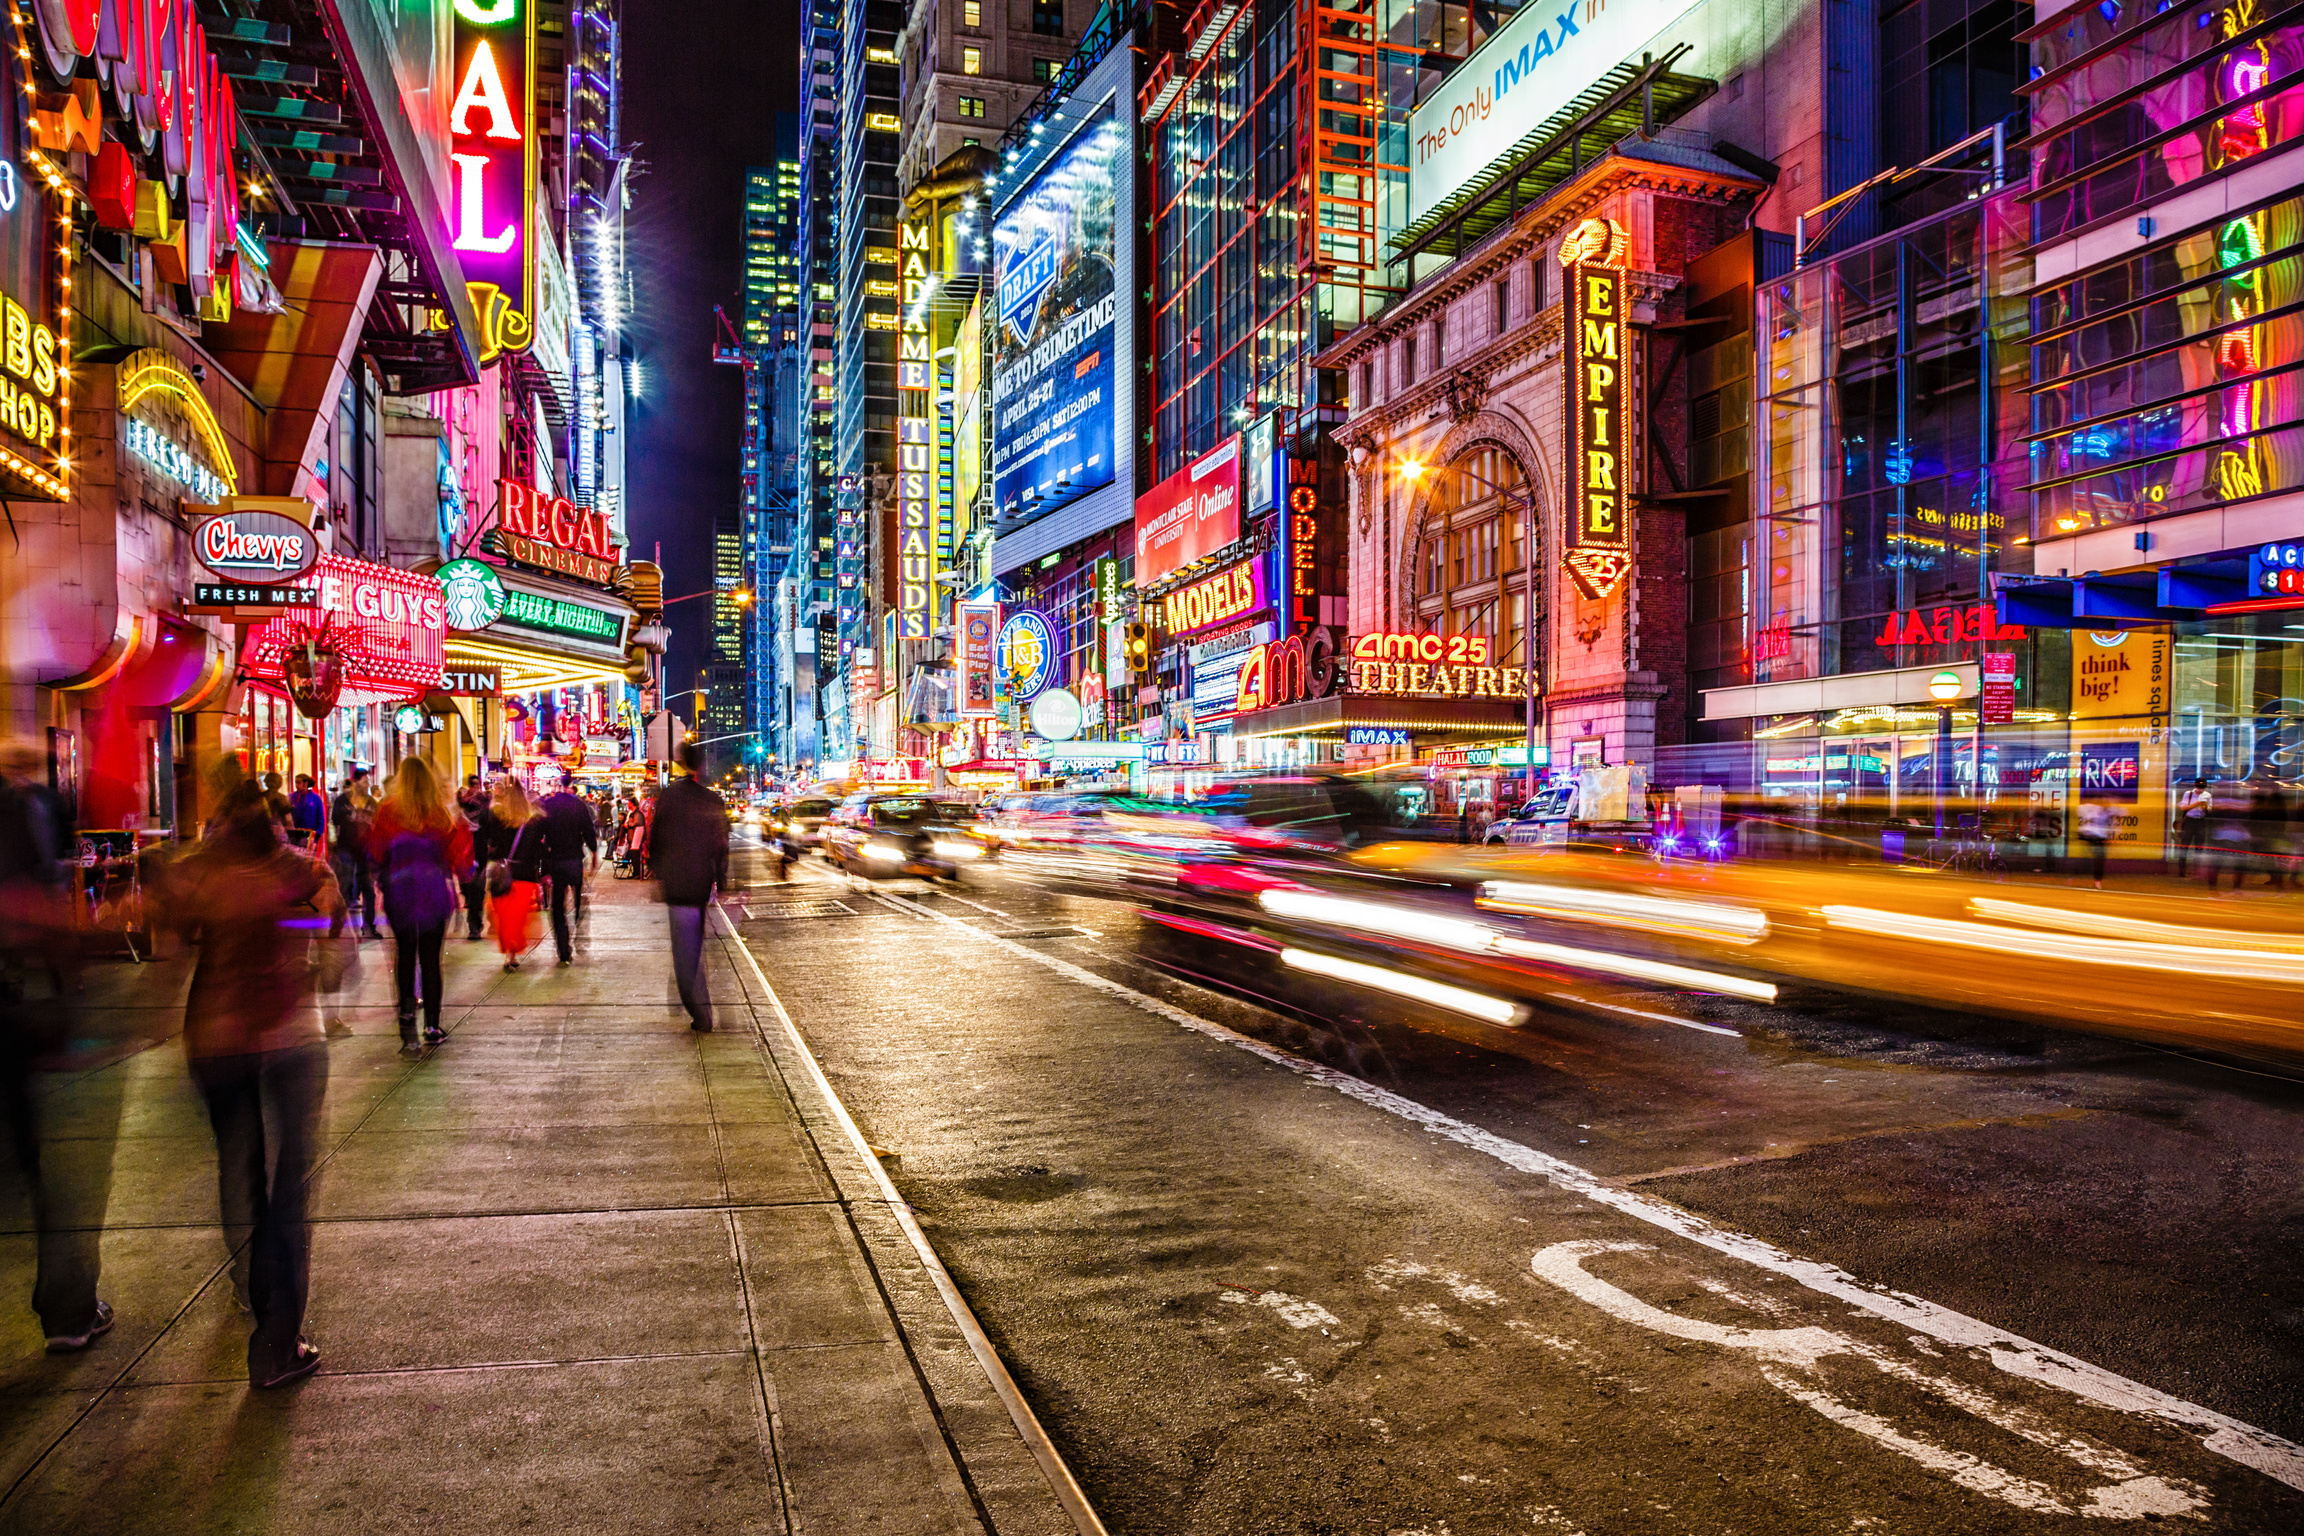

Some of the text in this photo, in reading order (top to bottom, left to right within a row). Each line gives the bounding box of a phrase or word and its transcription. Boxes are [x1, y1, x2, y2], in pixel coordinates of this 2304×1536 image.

[1417, 124, 1447, 165] The
[1450, 85, 1491, 137] Only
[1495, 0, 1580, 101] IMAX
[1003, 246, 1052, 311] DRAFT
[901, 223, 929, 388] MADAME
[0, 290, 56, 398] BS
[1013, 355, 1031, 390] TO
[1032, 291, 1115, 377] PRIMETIME
[1075, 350, 1100, 380] ESPN
[1002, 378, 1054, 431] APRIL 25-27
[1088, 387, 1101, 409] PM
[1583, 276, 1618, 533] EMPIRE
[501, 478, 619, 561] REGAL
[1146, 496, 1193, 535] MONTCLAIR STATE
[1199, 484, 1234, 521] Online
[204, 517, 302, 571] Chevys
[902, 418, 927, 638] TUSSAUD'S
[1154, 523, 1184, 550] UNIVERSITY
[513, 538, 609, 583] CINEMAS
[840, 478, 853, 653] CHAMPS
[1588, 555, 1617, 579] 25
[200, 589, 310, 603] FRESH MEX
[355, 584, 442, 630] GUYS
[1166, 562, 1255, 636] MODELL'S
[1023, 617, 1043, 637] AND
[1199, 619, 1253, 644] SPORTING GOODS
[969, 644, 989, 652] Eat
[969, 661, 989, 670] Play
[1001, 643, 1044, 671] D&B
[1447, 636, 1487, 663] 25
[2081, 652, 2131, 675] think
[1353, 661, 1540, 698] THEATRES
[2080, 675, 2118, 701] big!
[2147, 639, 2165, 745] times square
[1037, 712, 1078, 726] Hilton
[1350, 729, 1408, 745] IMAX
[986, 720, 999, 760] BBQ
[1437, 750, 1492, 766] HALAL FOOD
[2085, 758, 2134, 788] RKF
